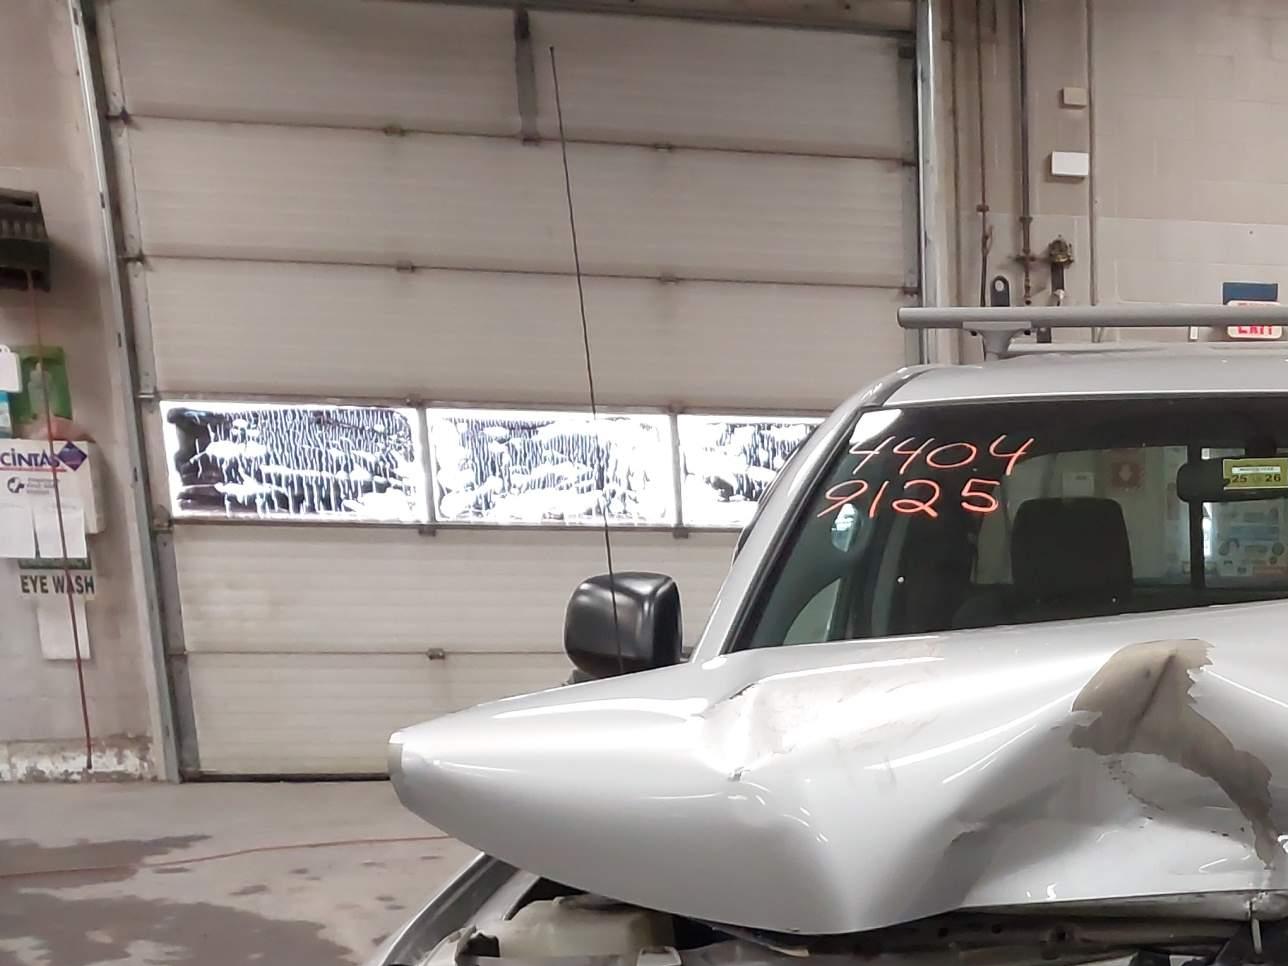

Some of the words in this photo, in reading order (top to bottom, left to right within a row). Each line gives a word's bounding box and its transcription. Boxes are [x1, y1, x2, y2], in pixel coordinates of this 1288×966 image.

[849, 435, 1034, 476] 4404
[1231, 474, 1248, 483] 25
[817, 479, 1000, 518] 9125
[20, 575, 49, 594] EYE
